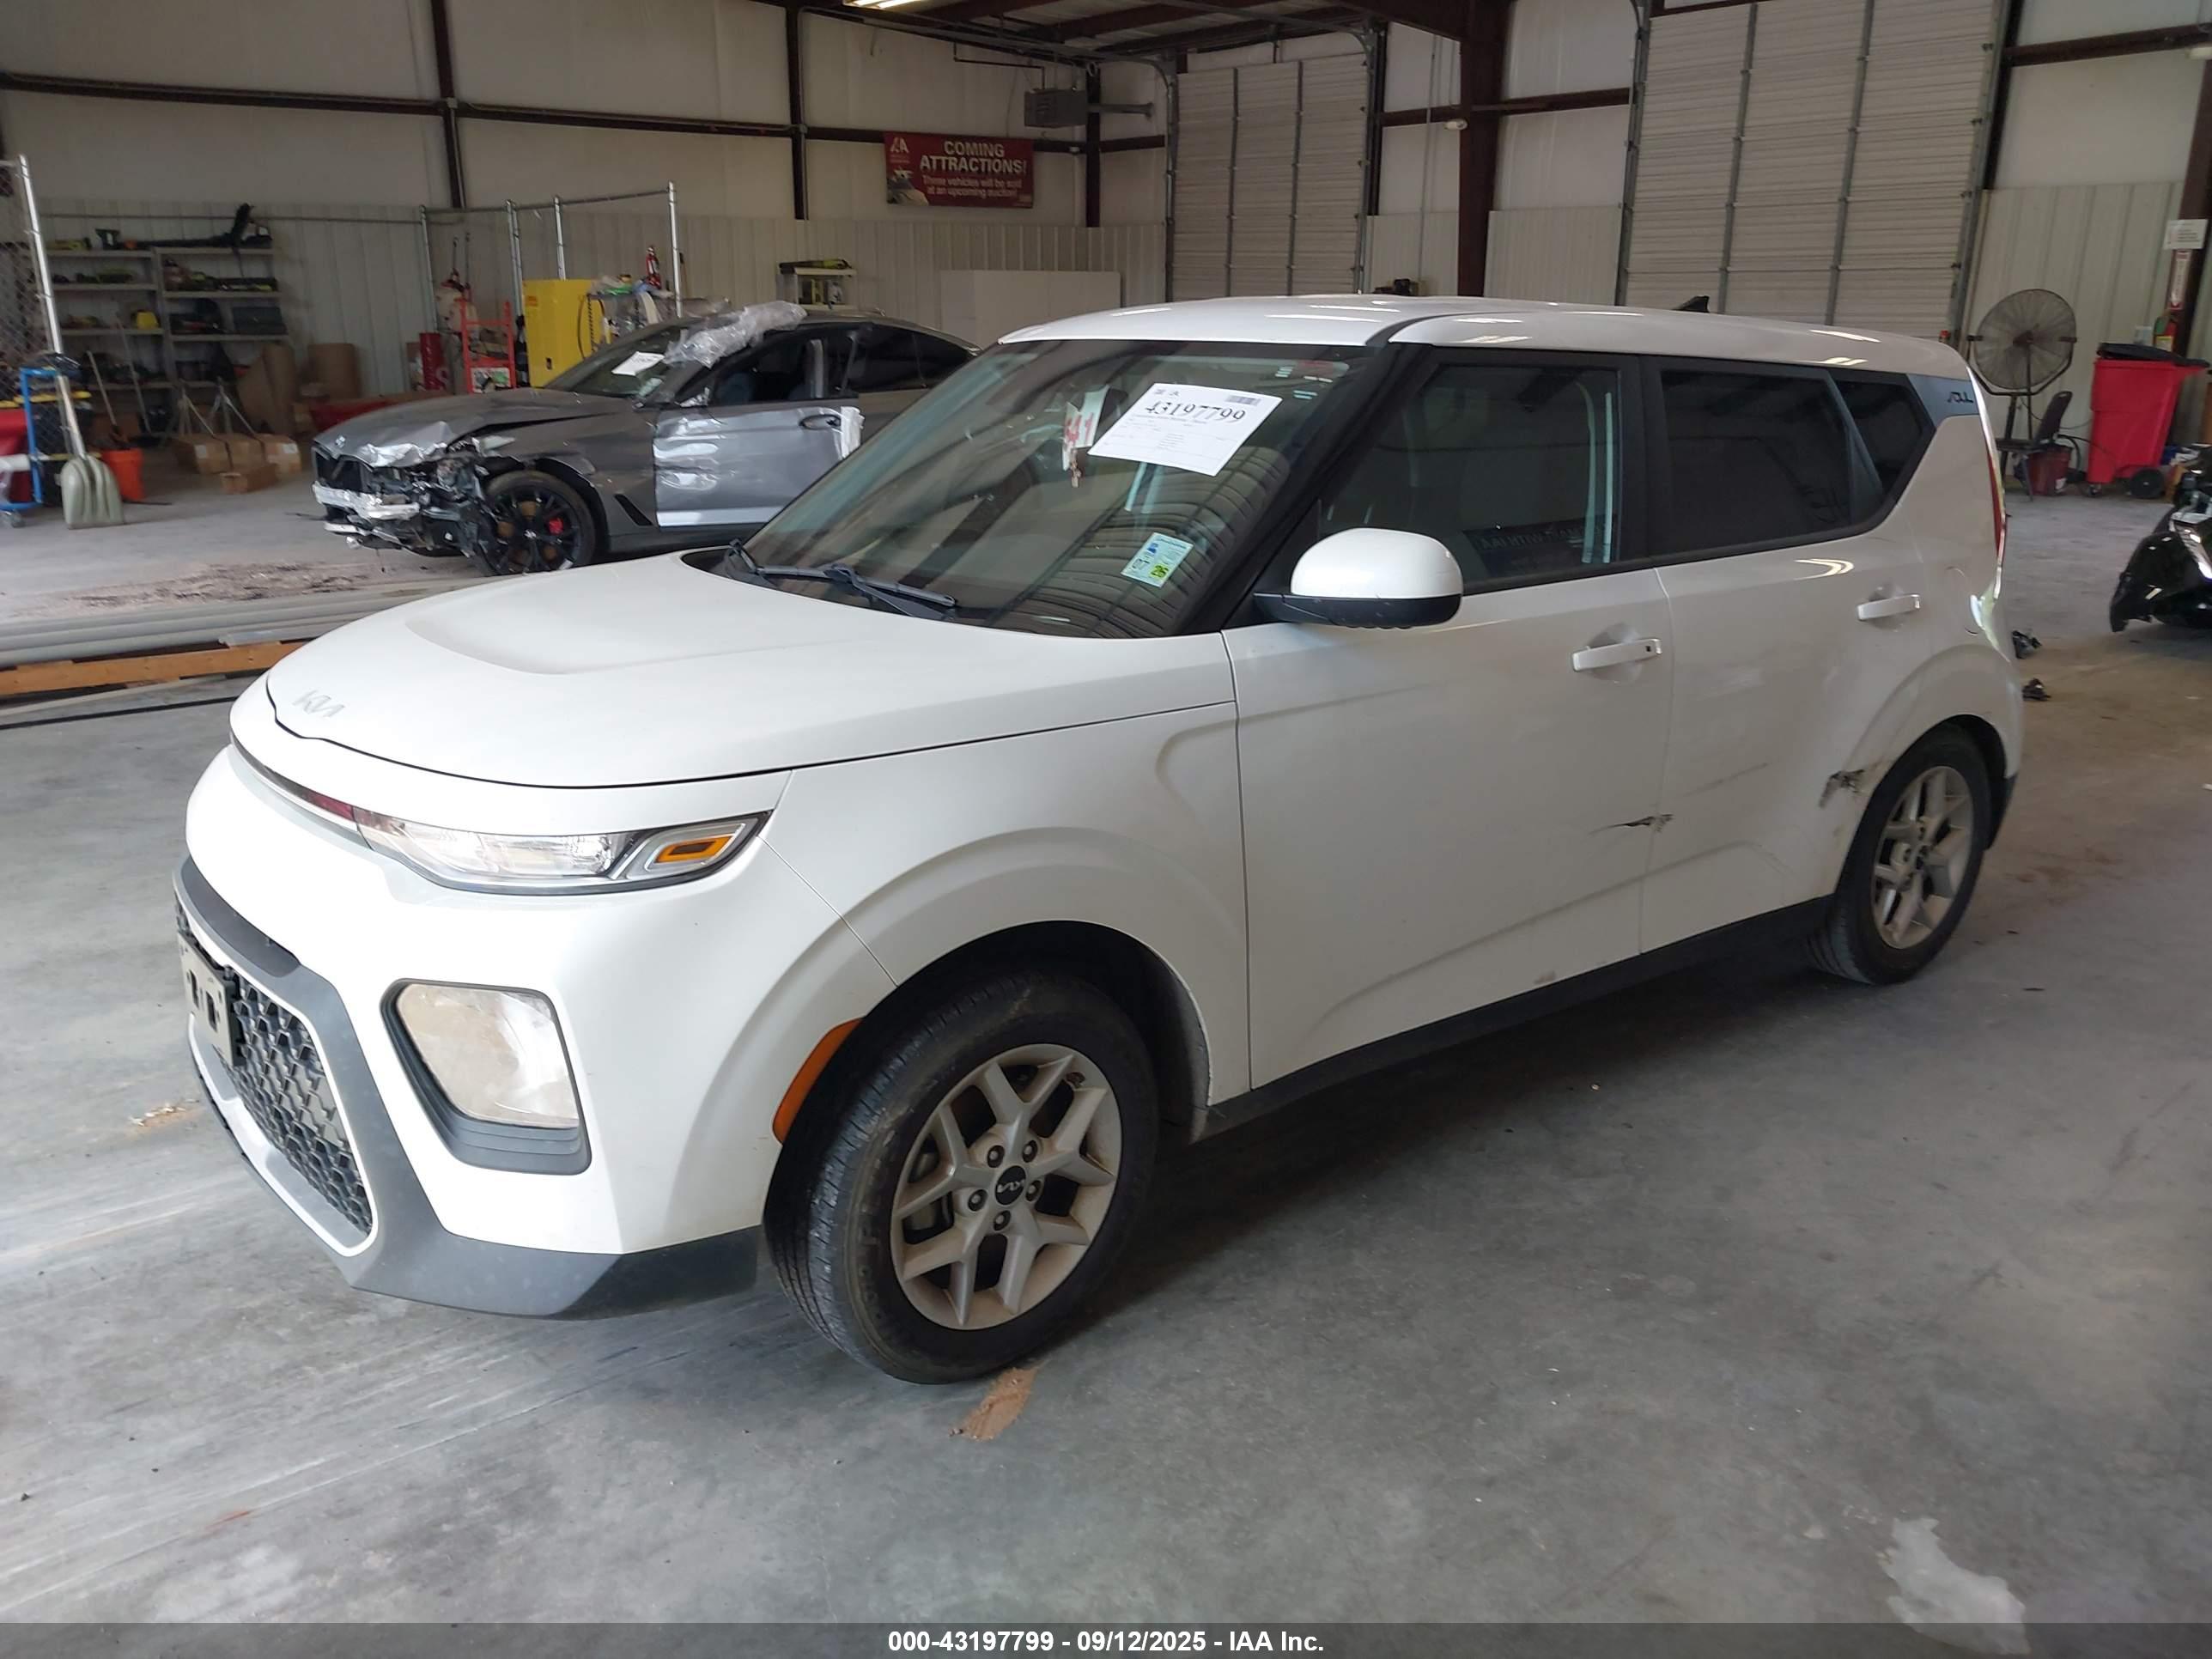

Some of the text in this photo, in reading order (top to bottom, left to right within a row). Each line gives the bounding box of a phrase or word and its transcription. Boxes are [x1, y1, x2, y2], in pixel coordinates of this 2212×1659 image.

[945, 142, 1005, 158] COMING
[920, 155, 1028, 174] ATTRACTIONS!
[1144, 401, 1247, 424] 43197799
